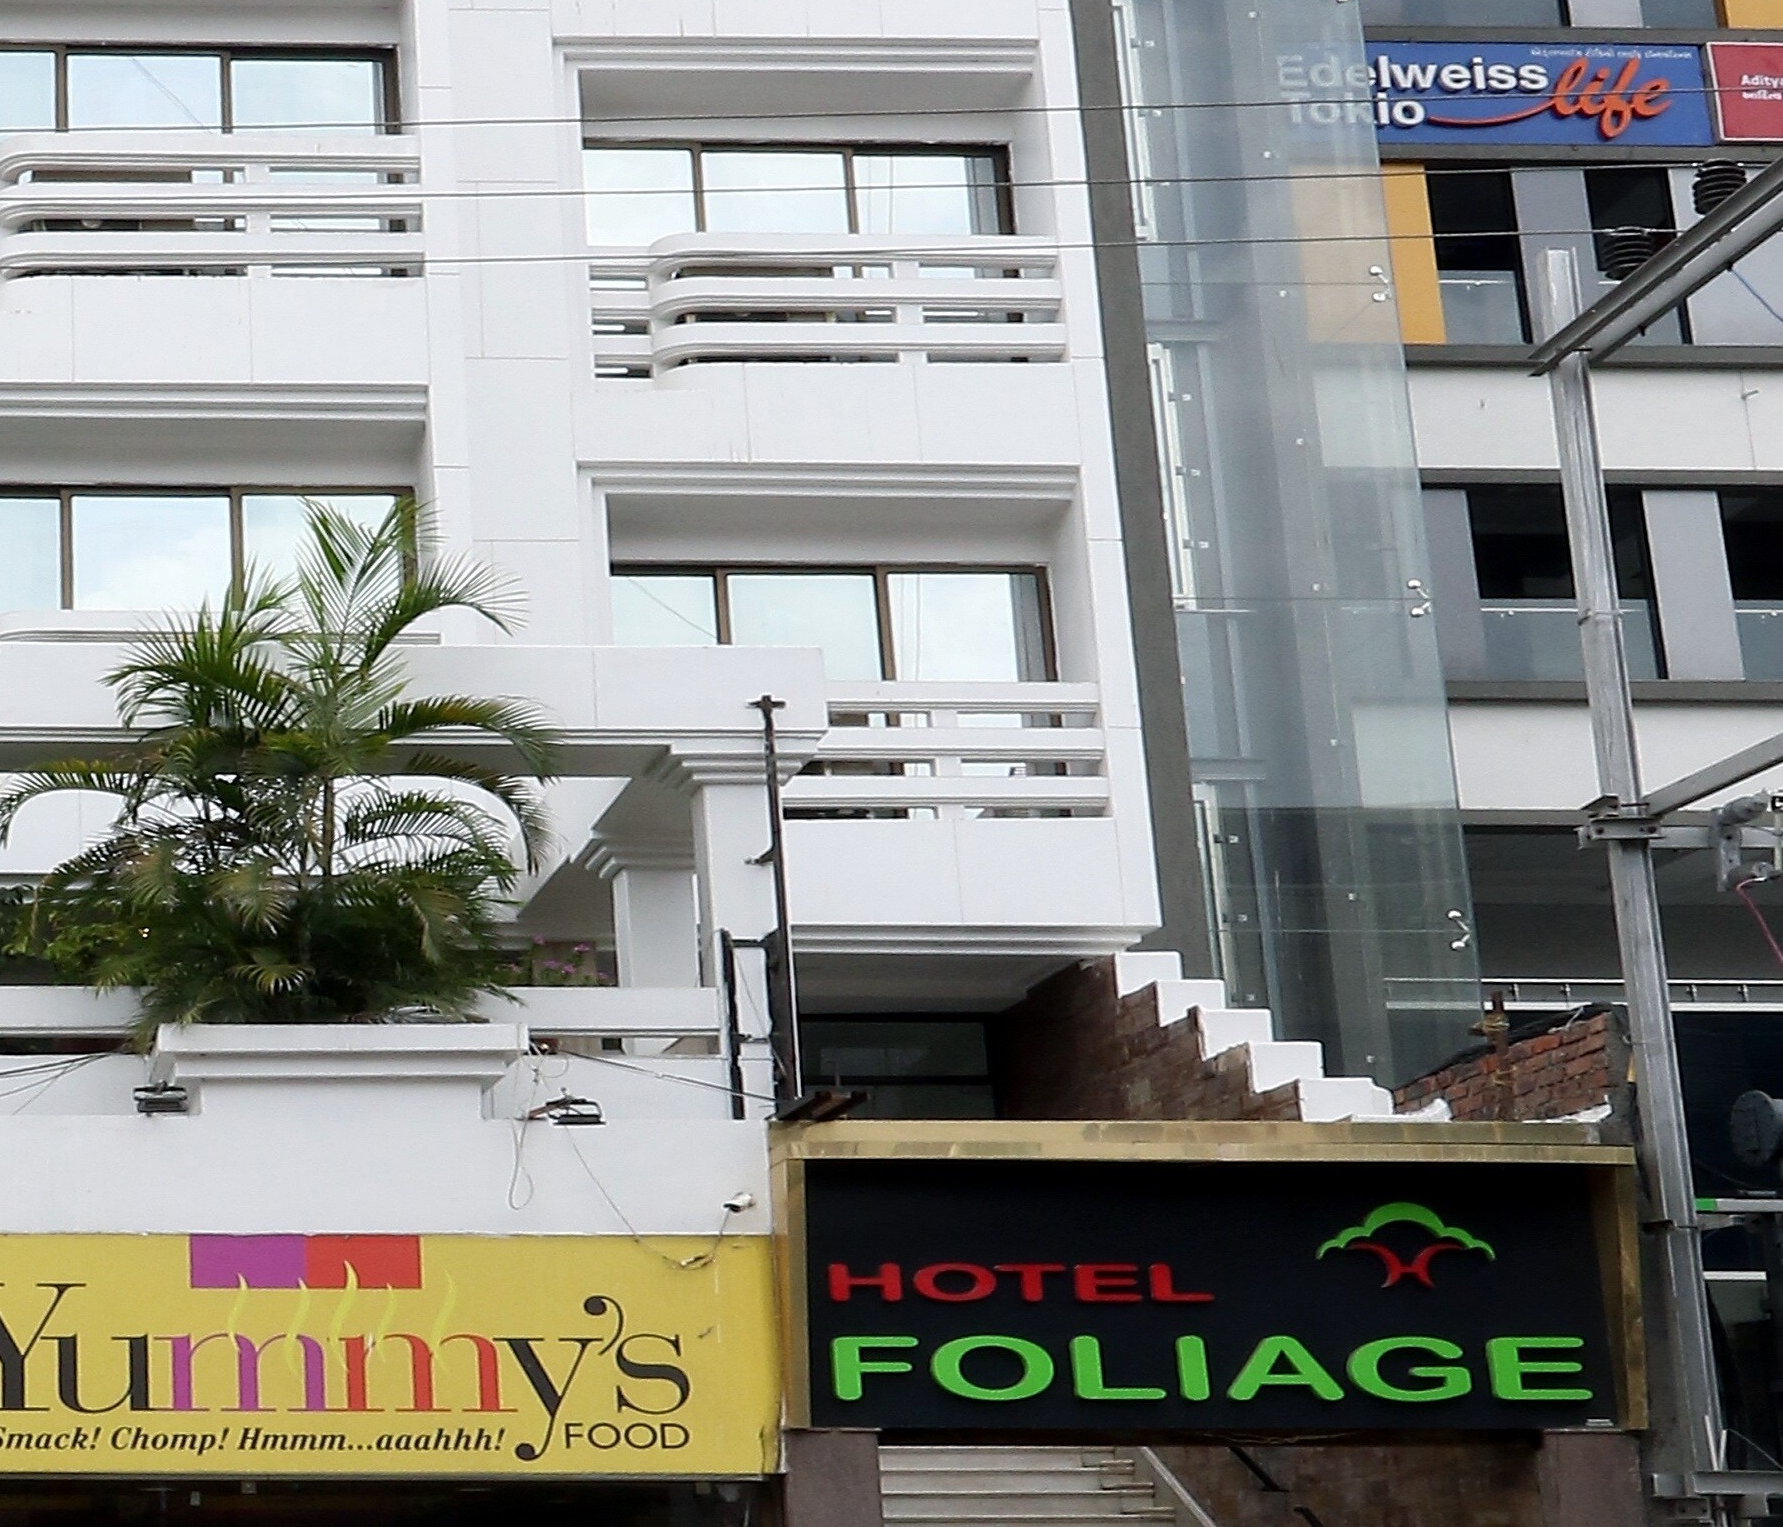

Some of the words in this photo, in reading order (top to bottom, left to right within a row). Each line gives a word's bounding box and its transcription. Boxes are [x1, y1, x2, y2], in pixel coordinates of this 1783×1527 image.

[1277, 55, 1549, 91] Edelweiss
[1282, 90, 1426, 127] Tokio
[1554, 56, 1672, 139] life
[828, 1263, 1215, 1302] HOTEL
[831, 1335, 1594, 1402] FOLIAGE
[108, 1425, 229, 1456] Chomp!
[563, 1421, 691, 1451] FOOD
